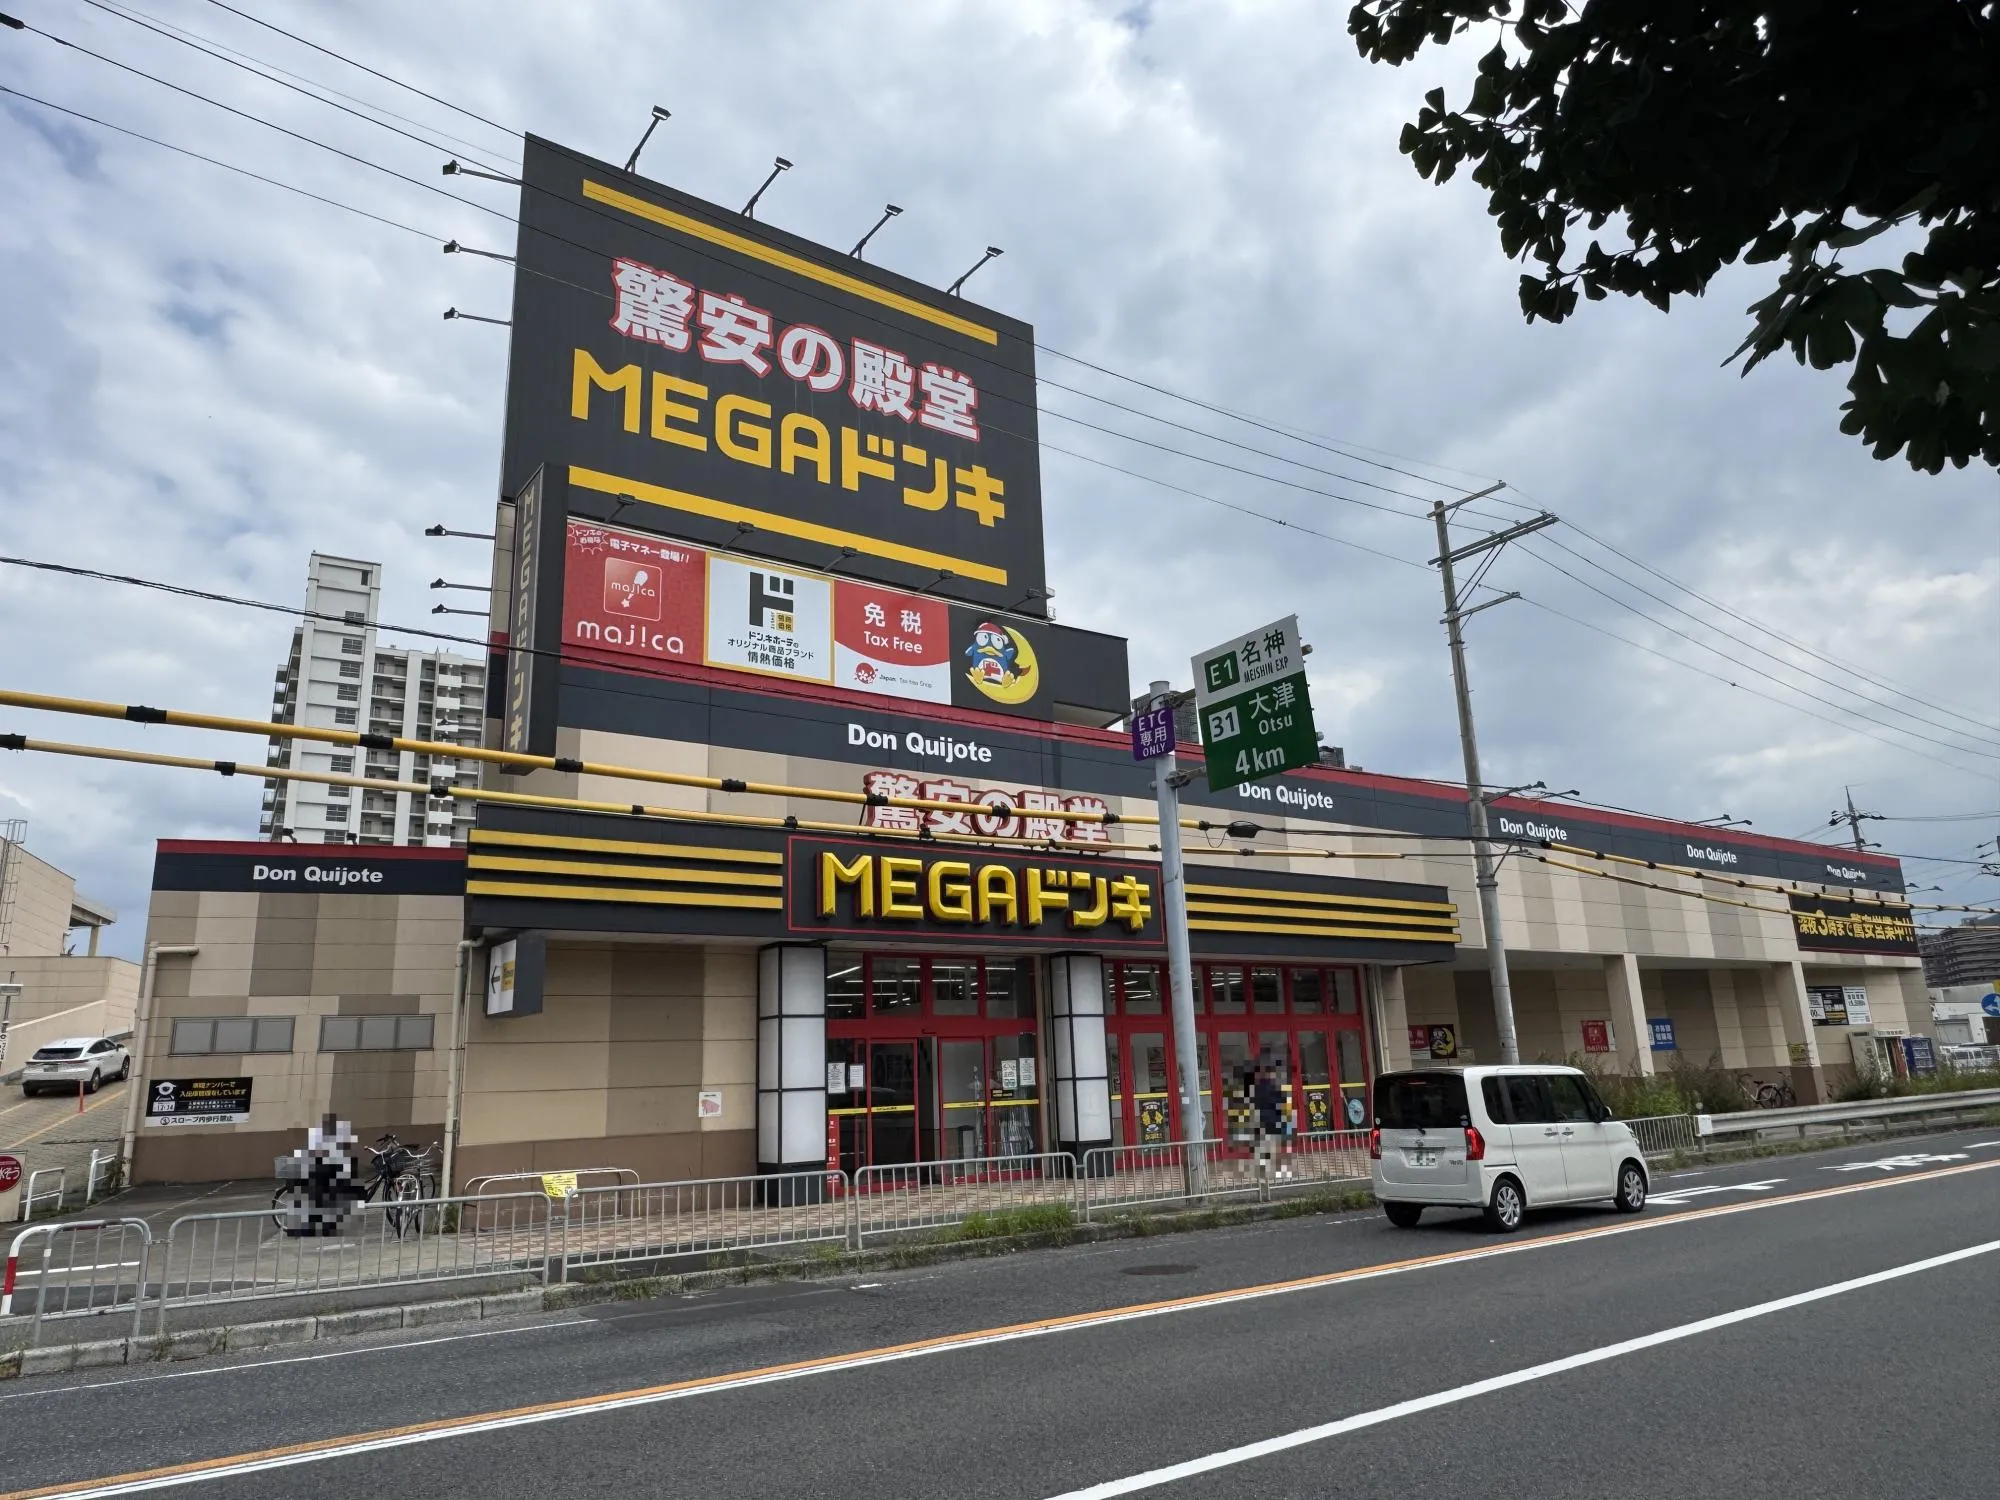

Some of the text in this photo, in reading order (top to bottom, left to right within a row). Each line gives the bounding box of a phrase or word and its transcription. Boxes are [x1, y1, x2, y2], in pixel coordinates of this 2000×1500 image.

[611, 258, 980, 442] 驚安の殿堂
[571, 348, 1005, 527] MEGAドンキ
[864, 602, 922, 635] 免税
[727, 638, 814, 660] オリジナル商品ブランド
[864, 631, 923, 654] Tax Free
[1240, 629, 1286, 667] 名神
[747, 650, 795, 669] 情熱価格
[1210, 658, 1234, 686] E1
[1244, 656, 1289, 684] MEISHIN EXP
[1249, 682, 1296, 720] 大津
[1138, 709, 1166, 732] ETC
[1211, 711, 1235, 738] 31
[1258, 713, 1293, 735] Otsu
[848, 723, 992, 763] Don Quijote
[1140, 727, 1167, 747] 専用
[1142, 743, 1166, 758] ONLY
[1239, 781, 1334, 810] Don Quijote
[865, 772, 1110, 848] 驚安の殿堂
[1500, 817, 1567, 842] Don Quijote
[1687, 844, 1737, 865] Don Quijote
[253, 865, 384, 886] Don Quijote
[818, 851, 1152, 931] MEGAドンキ
